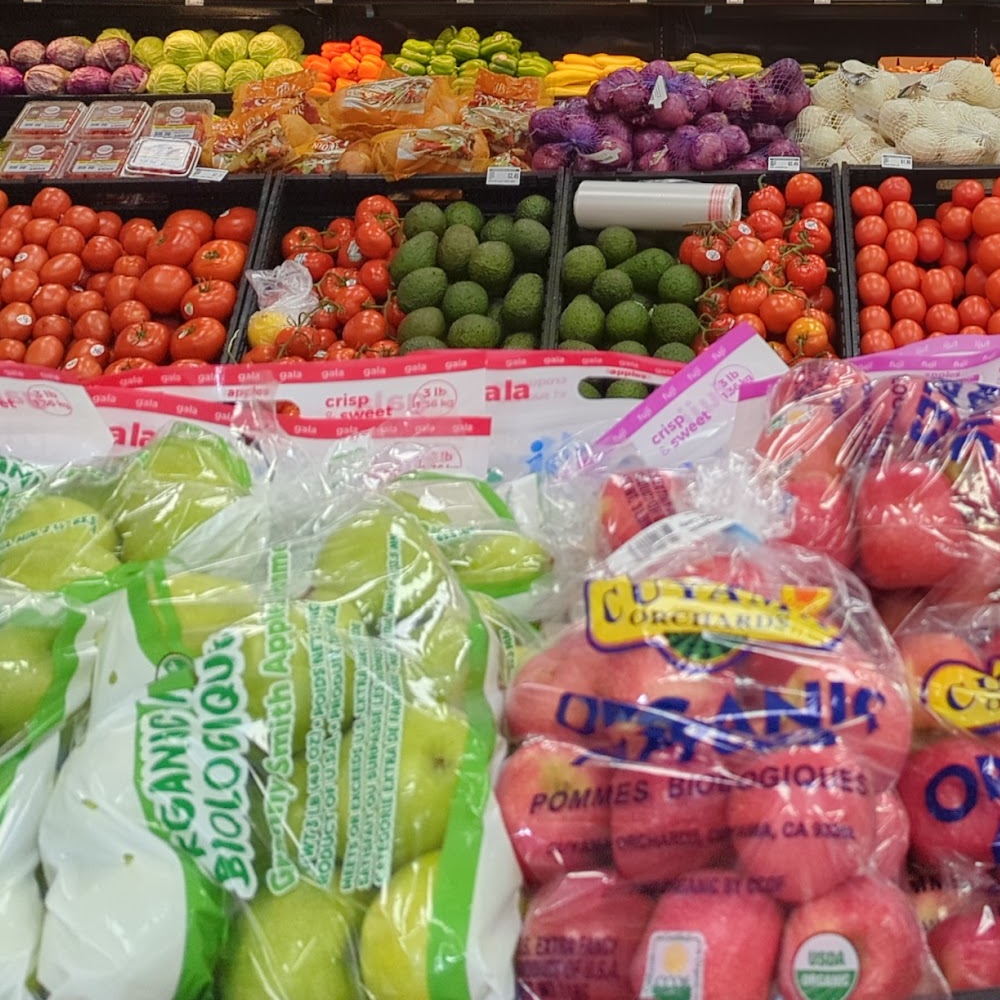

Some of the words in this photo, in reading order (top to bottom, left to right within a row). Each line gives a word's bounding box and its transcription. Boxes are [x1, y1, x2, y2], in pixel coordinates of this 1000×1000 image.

[321, 367, 345, 379] gala
[363, 365, 387, 377] gala
[404, 361, 427, 373] gala
[444, 358, 468, 370] gala
[120, 375, 144, 387] gala
[160, 372, 182, 384] gala
[279, 370, 303, 381] gala
[726, 369, 740, 384] lb
[92, 393, 117, 406] gala
[325, 392, 370, 409] crisp
[423, 387, 432, 398] 3
[434, 386, 447, 398] lb
[484, 379, 531, 402] ala
[135, 397, 160, 411] gala
[176, 402, 199, 416] gala
[339, 405, 394, 419] sweet
[110, 422, 157, 448] ala
[293, 424, 318, 436] gala
[651, 413, 686, 446] crisp
[669, 408, 713, 448] sweet
[629, 605, 791, 630] ORCHARDS
[313, 666, 327, 717] POIDS
[355, 669, 369, 714] EXTRA
[263, 681, 293, 776] Smith
[309, 732, 323, 760] OZ)
[366, 711, 383, 780] SURPASSE
[350, 748, 363, 811] EXCEEDS
[383, 749, 398, 793] EXTRA
[324, 787, 337, 808] OF
[529, 778, 650, 814] POMMES
[669, 763, 869, 801] BIOLOGIQUES
[308, 796, 321, 816] LB
[350, 817, 361, 837] OR
[318, 812, 337, 886] RODUCT
[343, 841, 359, 890] MEETS
